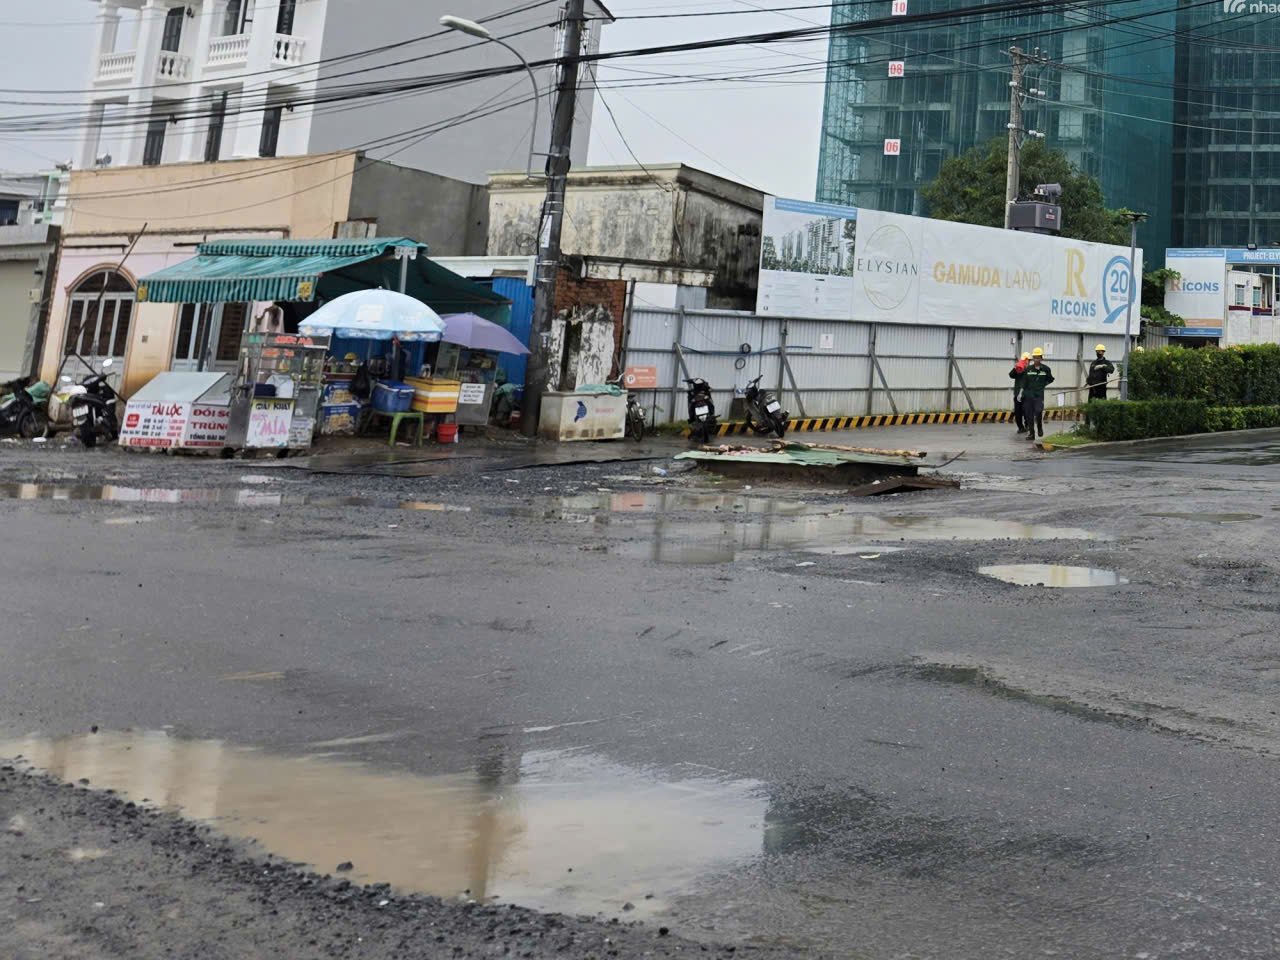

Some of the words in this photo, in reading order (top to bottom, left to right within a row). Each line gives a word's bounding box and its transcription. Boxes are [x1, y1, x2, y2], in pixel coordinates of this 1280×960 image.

[894, 2, 906, 13] 10
[890, 63, 903, 75] 08
[886, 141, 899, 153] 06
[857, 257, 919, 276] ELYSIAN
[933, 260, 1001, 288] GAMUDA
[1005, 269, 1041, 291] LAND
[1110, 269, 1129, 294] 20
[1051, 299, 1097, 317] RICONS
[152, 402, 165, 416] TÀI
[166, 403, 183, 418] LỘC
